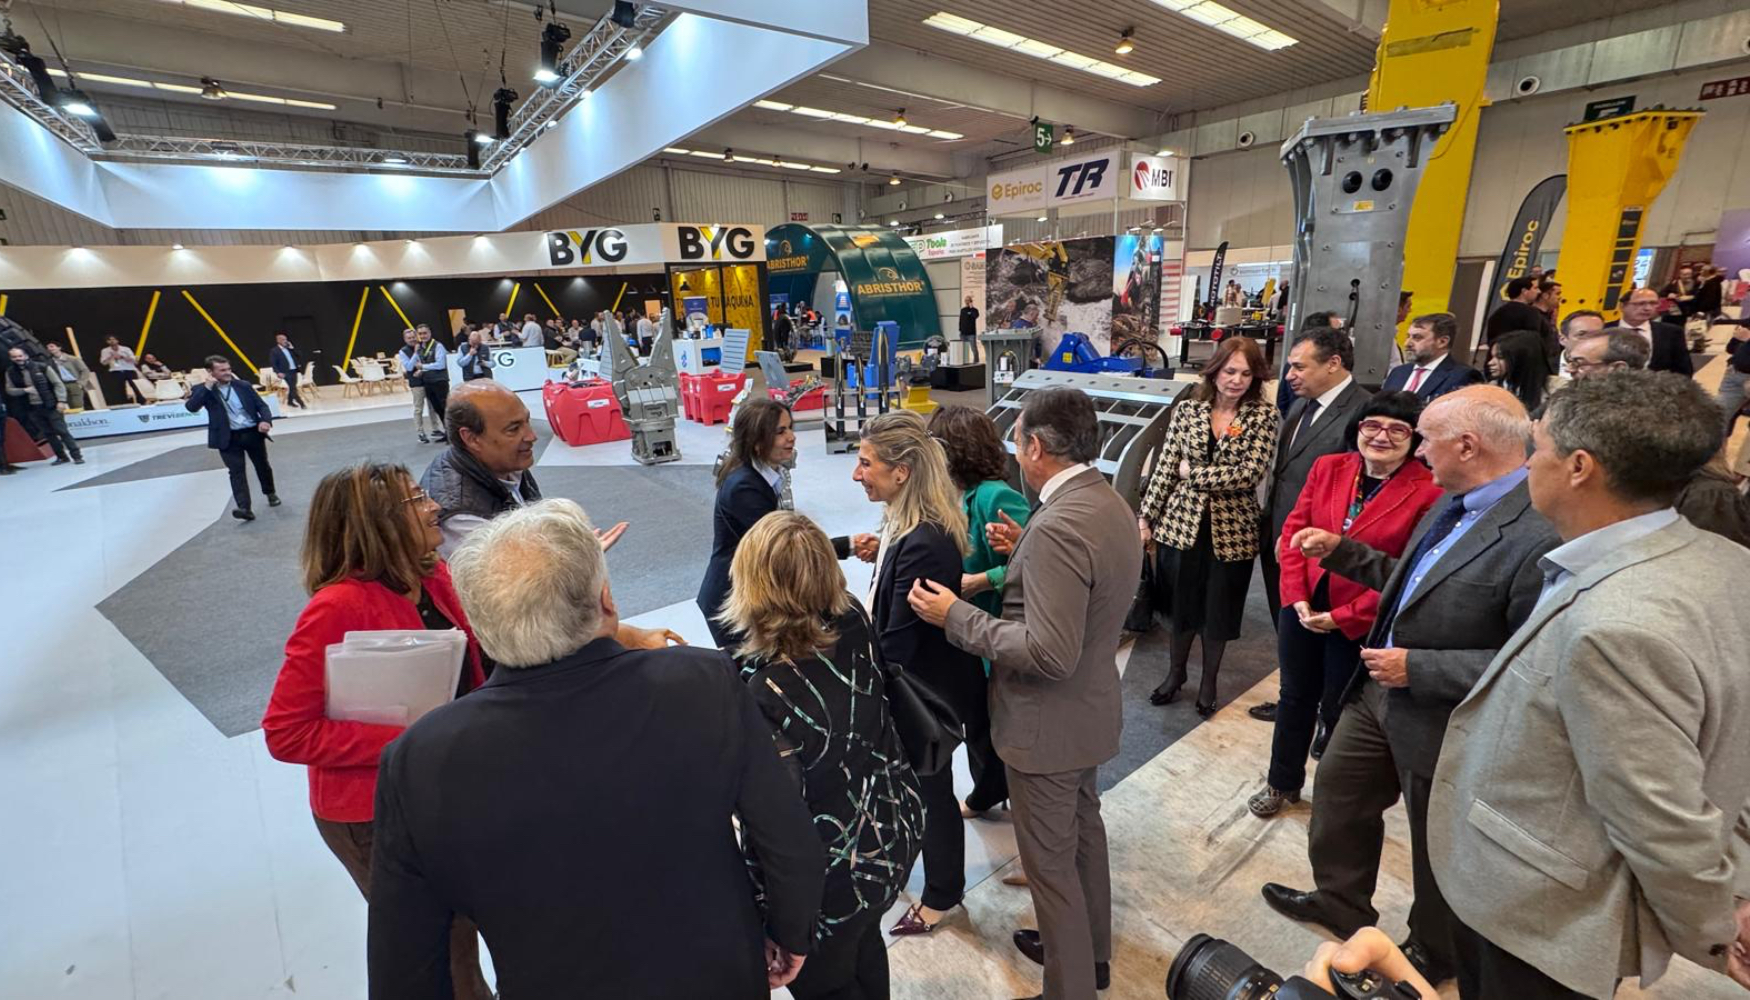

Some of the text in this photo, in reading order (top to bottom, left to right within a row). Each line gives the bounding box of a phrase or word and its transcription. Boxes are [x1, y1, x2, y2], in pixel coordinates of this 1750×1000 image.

[1036, 127, 1045, 147] 5
[1005, 181, 1042, 199] Epiroc
[1055, 158, 1110, 198] TR
[1151, 169, 1172, 188] MBI
[547, 227, 628, 266] BYG
[678, 226, 755, 260] BYG
[1507, 219, 1539, 279] Epiroc
[857, 281, 924, 295] ABRISTHOR
